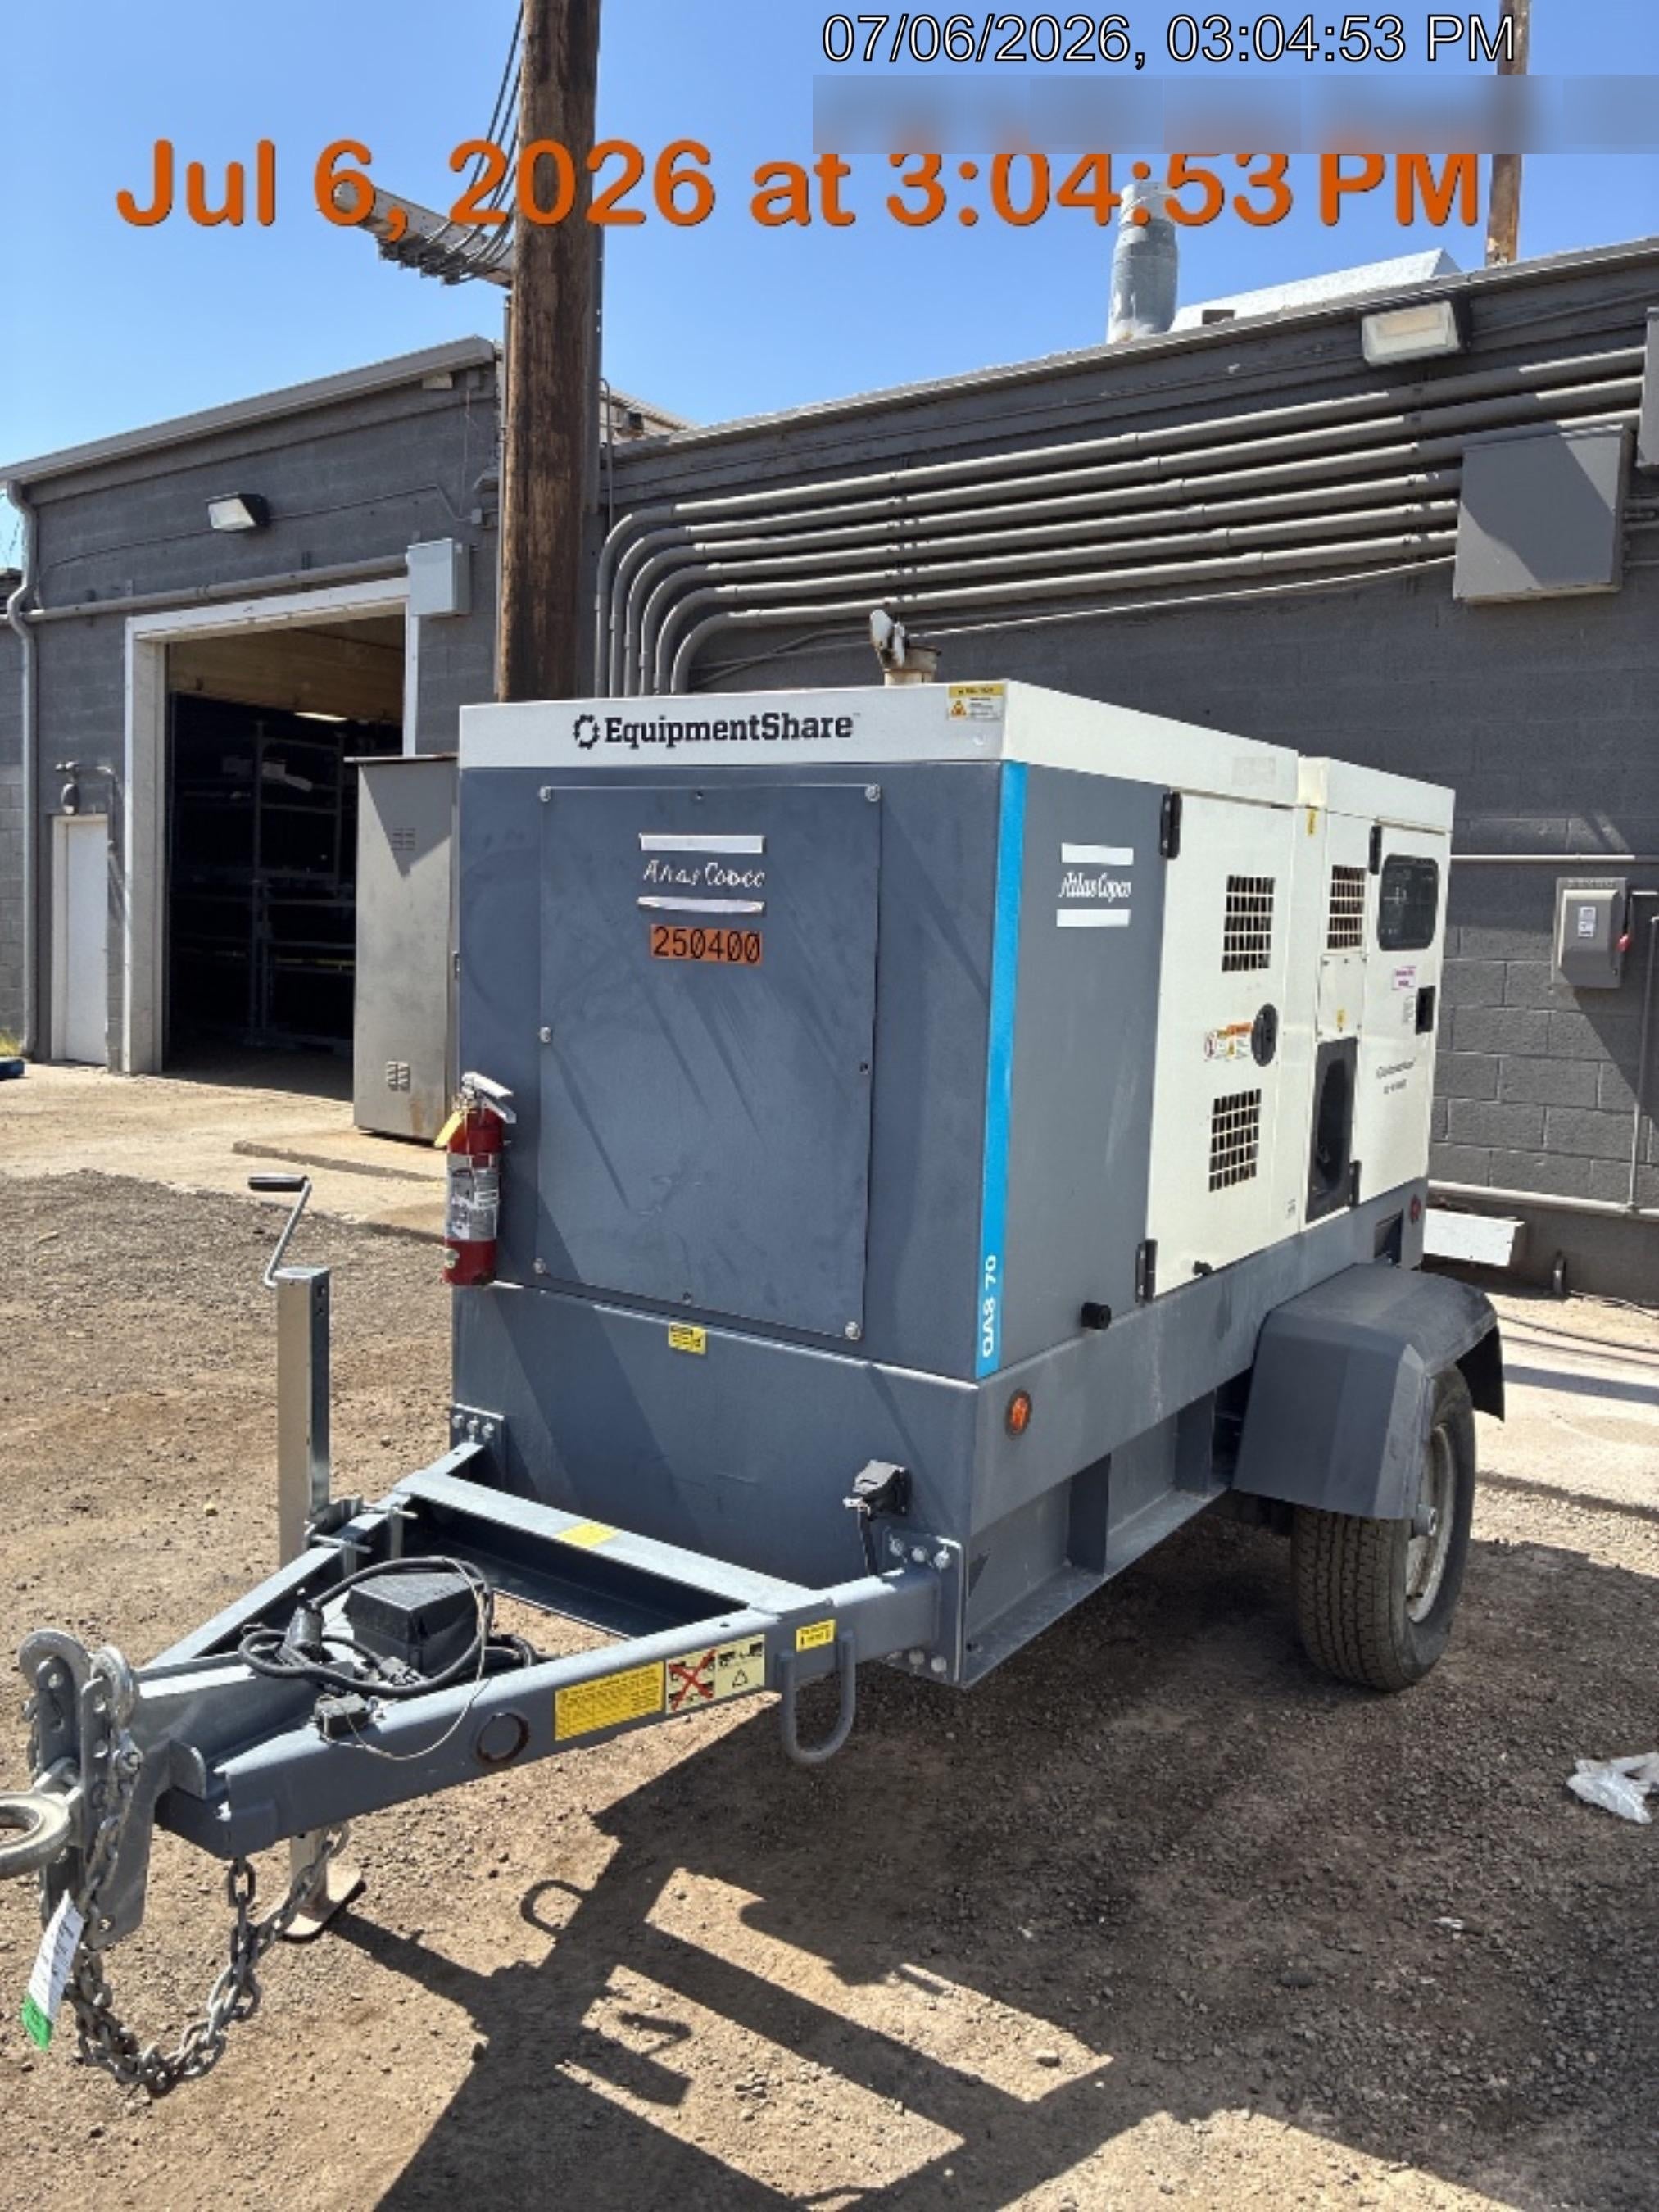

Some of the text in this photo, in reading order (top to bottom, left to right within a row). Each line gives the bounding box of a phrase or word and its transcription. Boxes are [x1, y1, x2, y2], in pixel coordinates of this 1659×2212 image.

[604, 711, 854, 749] EquipmentShare
[1058, 871, 1097, 899] Atlas
[653, 926, 760, 963] 250400
[985, 1254, 997, 1291] 70
